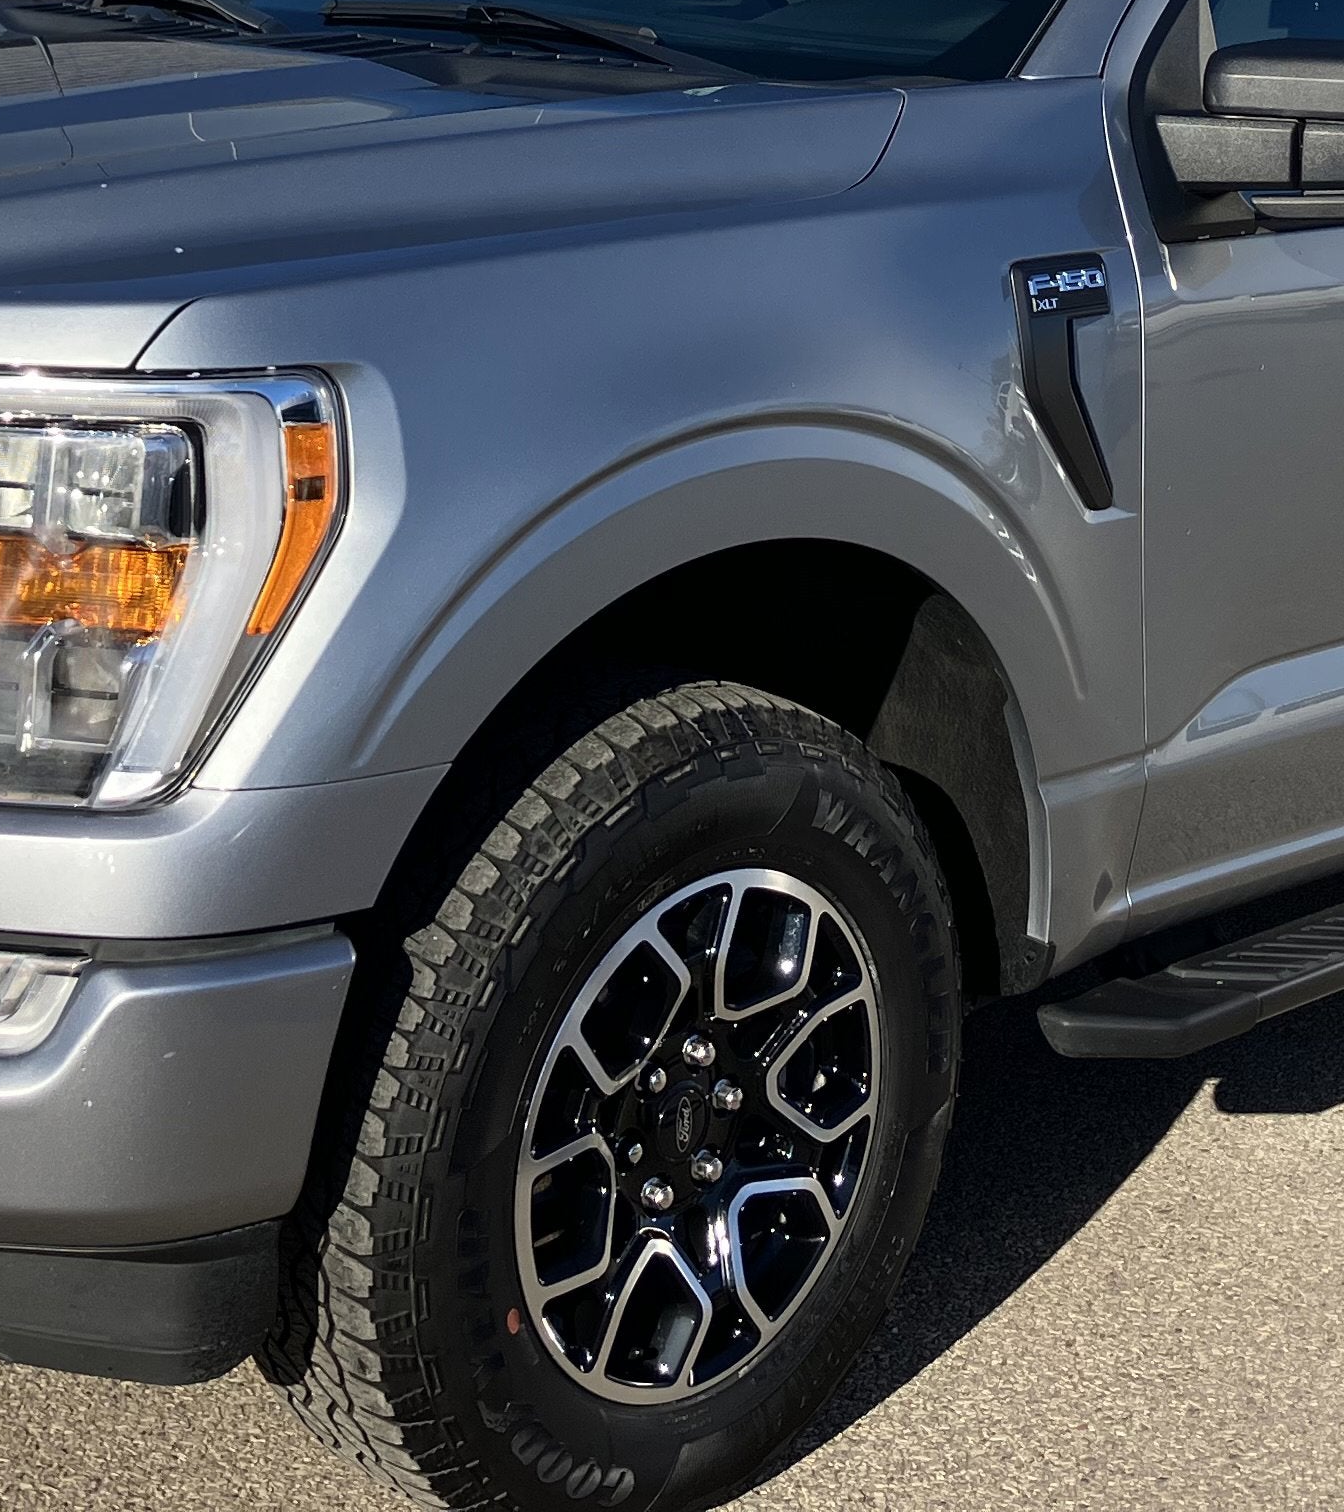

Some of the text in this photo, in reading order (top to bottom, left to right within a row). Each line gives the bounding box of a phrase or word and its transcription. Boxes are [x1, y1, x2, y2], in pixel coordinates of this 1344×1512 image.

[1028, 268, 1105, 295] F-150
[1037, 298, 1058, 311] XLT
[679, 1107, 691, 1142] Ford
